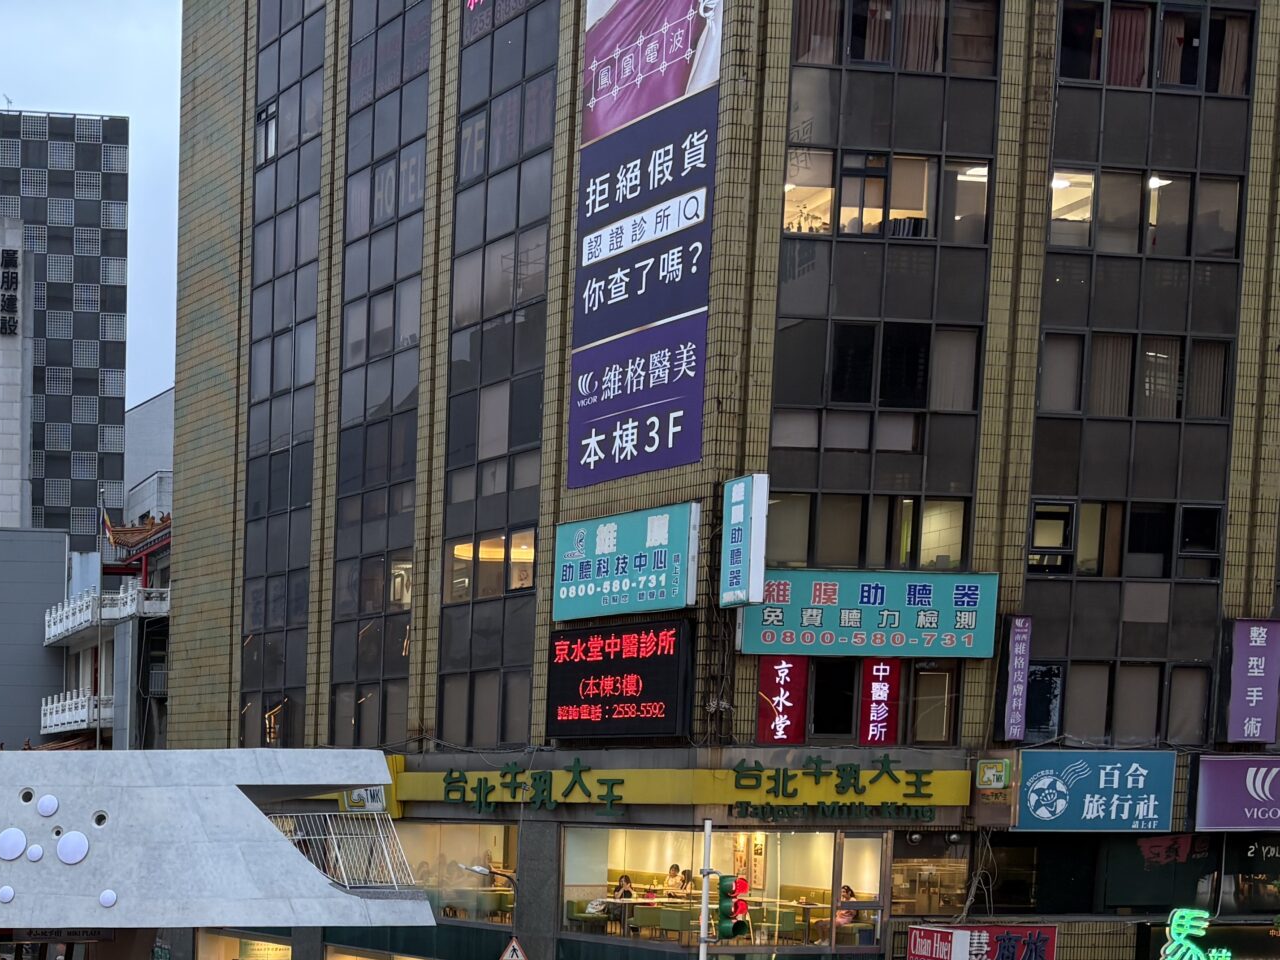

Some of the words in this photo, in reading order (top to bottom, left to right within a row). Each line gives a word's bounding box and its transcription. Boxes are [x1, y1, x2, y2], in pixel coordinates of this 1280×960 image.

[597, 28, 685, 92] 鳳凰電波
[585, 129, 708, 218] 拒絕假貨
[587, 207, 671, 258] 認證診所
[0, 249, 19, 336] 廣朋建設
[601, 342, 696, 401] 維格醫美
[580, 410, 684, 470] 本棟3F
[559, 573, 667, 599] 0800-580-731
[561, 549, 668, 582] 助聽科技中心
[764, 580, 980, 607] 維膜助聽器
[761, 630, 975, 647] 0800-580-731
[762, 608, 977, 629] 免費聽力檢測
[554, 629, 677, 664] 京水堂中醫診所
[770, 661, 794, 739] 京水堂
[867, 662, 891, 741] 中醫診所
[1008, 642, 1027, 738] 維格皮膚科診所
[1244, 626, 1268, 737] 整型手術
[442, 757, 625, 816] 台北牛乳大王
[733, 753, 933, 799] 台北牛乳大王
[1026, 769, 1054, 787] SUCCESS
[1098, 763, 1149, 789] 百合
[730, 801, 808, 822] Taipei
[816, 801, 871, 818] Milk
[880, 801, 936, 822] King
[1081, 794, 1159, 820] 旅行社
[911, 929, 931, 955] Chian
[932, 933, 951, 960] Huei
